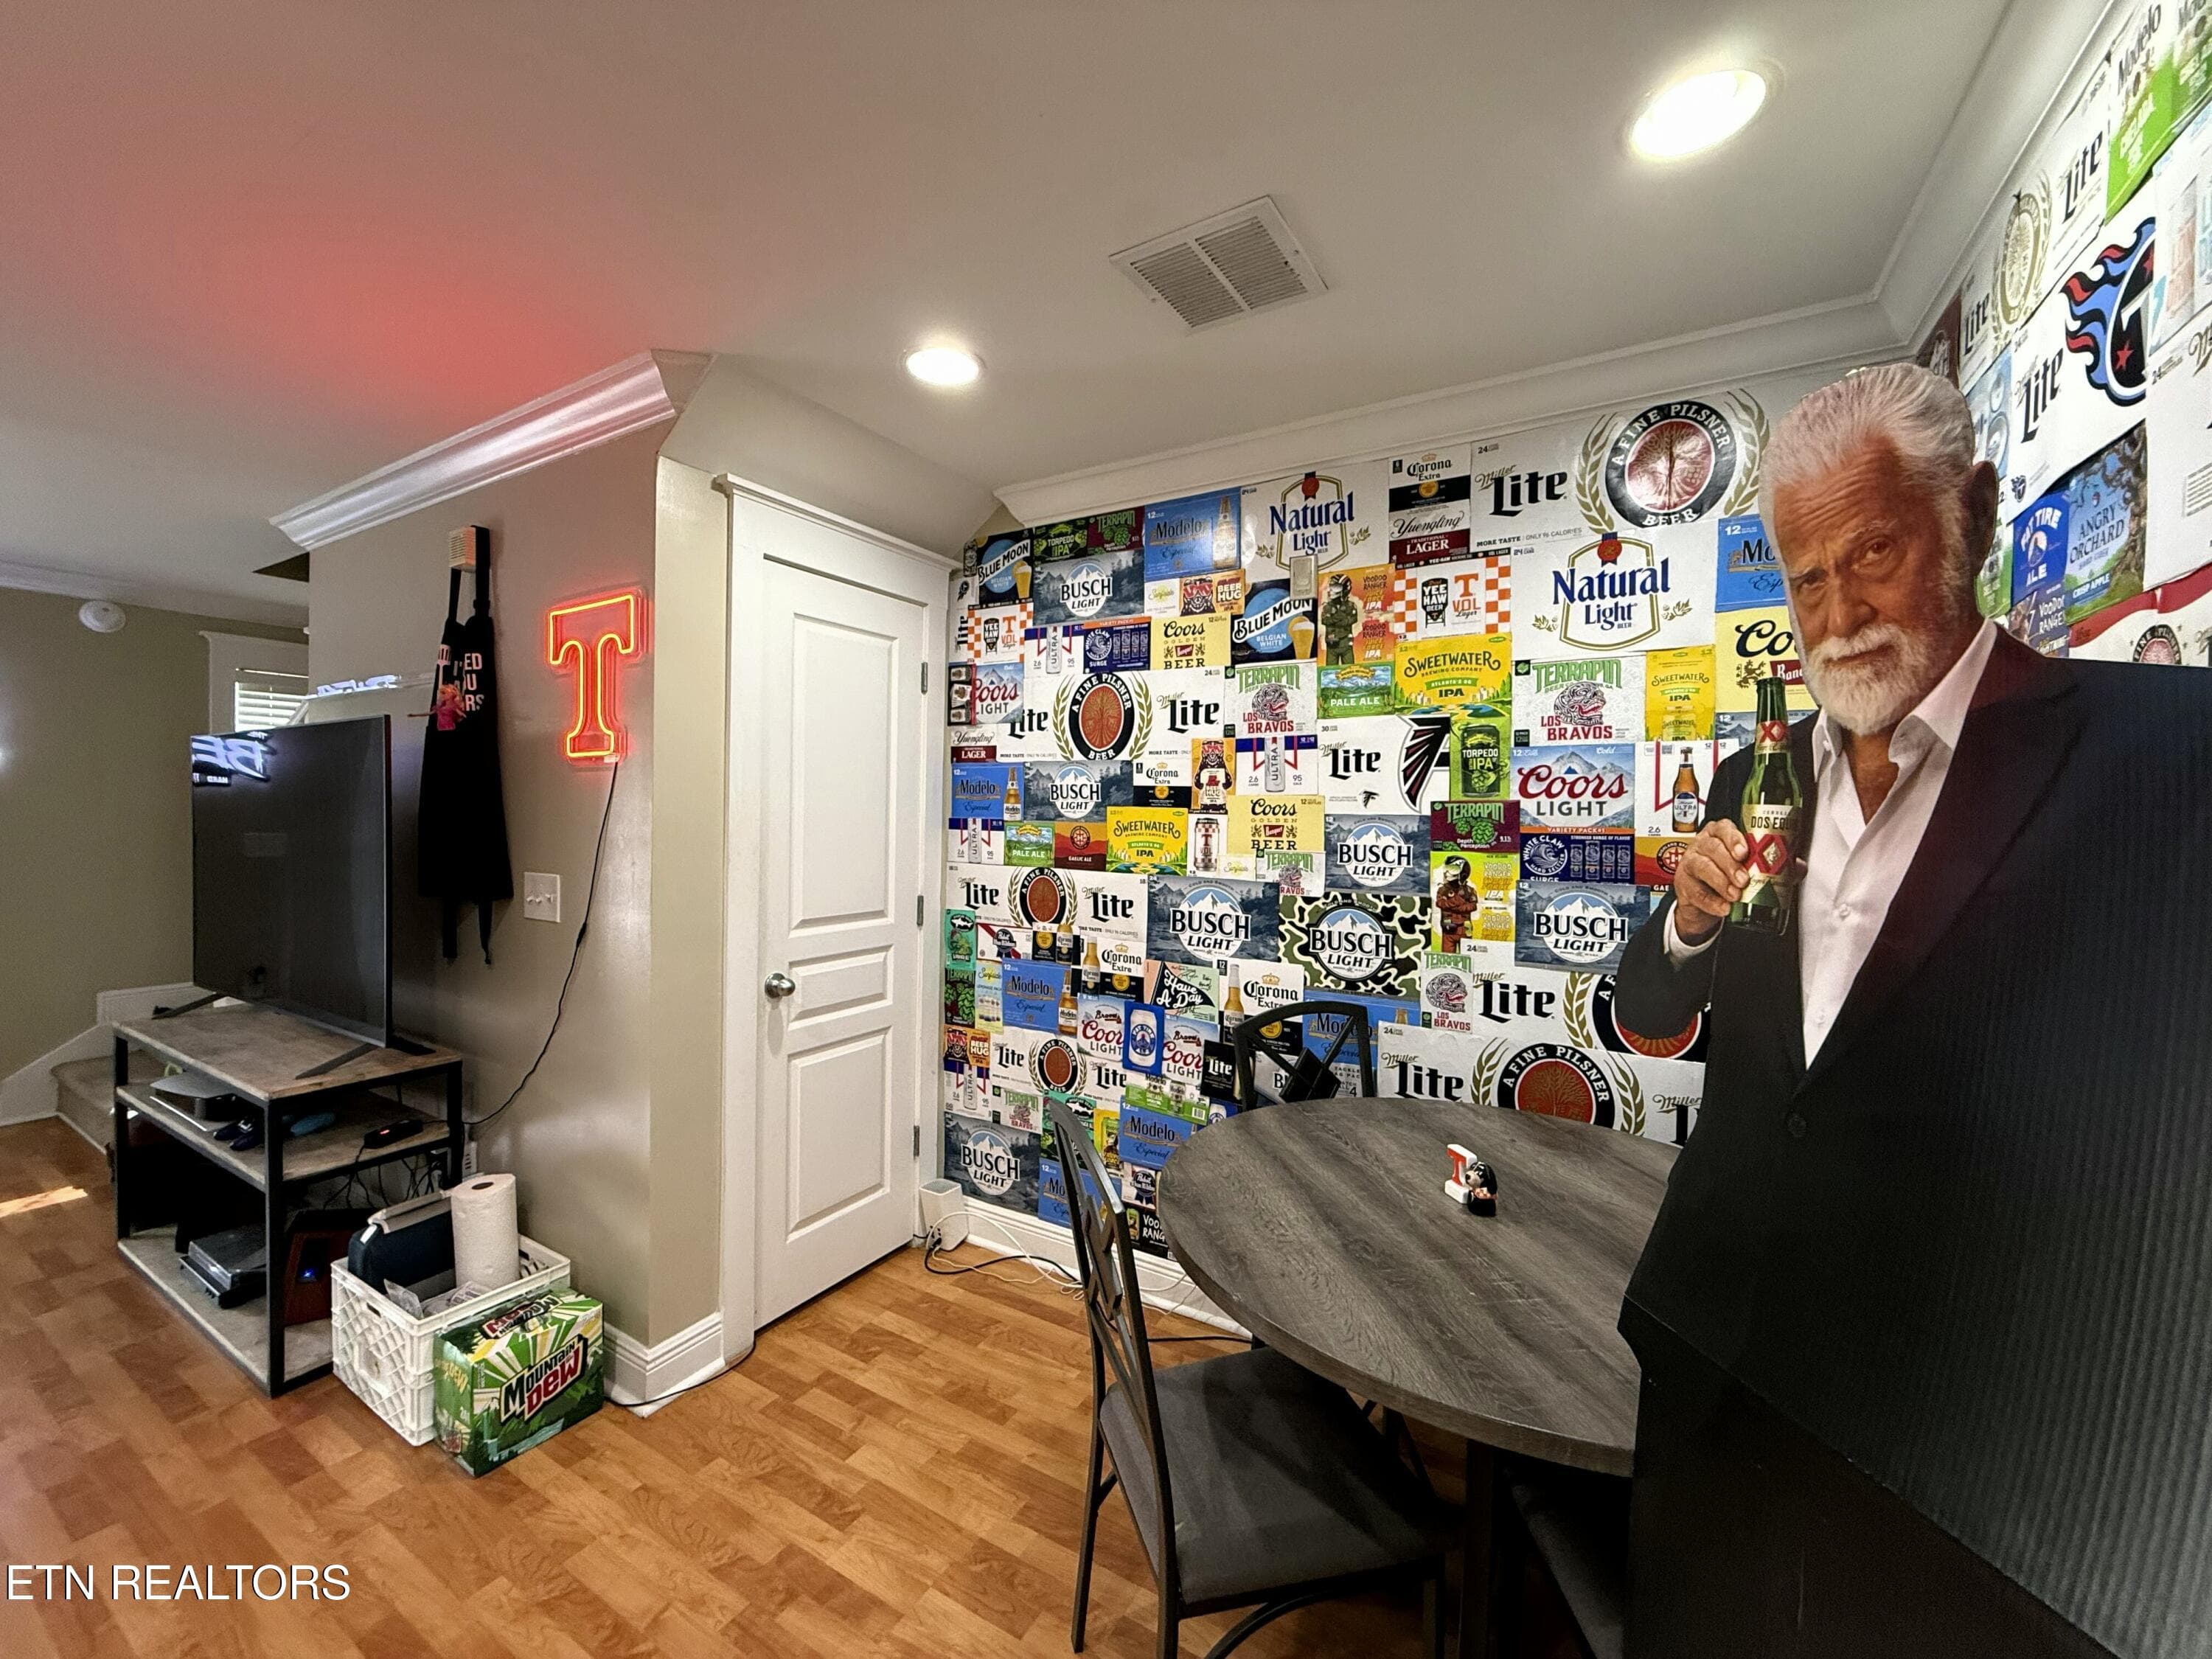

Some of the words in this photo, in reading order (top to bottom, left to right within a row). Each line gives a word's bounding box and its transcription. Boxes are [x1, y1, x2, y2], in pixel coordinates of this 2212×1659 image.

[2065, 131, 2102, 220] Lite
[2021, 348, 2063, 443] Lite
[1612, 455, 1624, 465] A
[1618, 411, 1660, 450] FINE
[1671, 405, 1731, 449] PILSNER
[1478, 445, 1488, 454] 24
[1407, 457, 1452, 477] Corona
[1418, 472, 1441, 481] Extra
[1475, 465, 1517, 491] Miller
[1490, 469, 1568, 517] Lite
[1096, 511, 1135, 532] TERRAPIN
[1270, 491, 1354, 535] Natural
[1642, 508, 1700, 526] BEER
[2035, 507, 2062, 529] TIRE
[2079, 502, 2117, 540] ANGRY
[1390, 511, 1466, 540] Yuengling
[1725, 526, 1742, 535] 12
[1048, 535, 1074, 546] TORPEDO
[1293, 532, 1329, 556] Light
[1406, 539, 1450, 554] LAGER
[1498, 535, 1521, 545] TASTE
[2070, 519, 2124, 564] ORCHARD
[1057, 544, 1069, 555] IPA
[978, 562, 1001, 582] BLUE
[1003, 542, 1029, 564] MOON
[1062, 579, 1111, 601] BUSCH
[1423, 584, 1447, 594] YEE
[1455, 573, 1478, 597] T
[1553, 557, 1671, 605] Natural
[2091, 574, 2110, 591] APPLE
[1071, 598, 1101, 609] LIGHT
[1217, 591, 1242, 602] HUG
[1424, 594, 1447, 605] HAW
[1453, 598, 1481, 612] VOL
[1366, 602, 1382, 610] IPA
[1585, 601, 1633, 631] Light
[1095, 629, 1110, 638] CLAW
[1164, 621, 1206, 638] Coors
[1234, 615, 1270, 642] BLUE
[1365, 650, 1381, 658] IPA
[1164, 658, 1205, 669] BEER
[1404, 651, 1501, 678] SWEETWATER
[1236, 664, 1300, 693] TERRAPIN
[1531, 659, 1622, 695] TERRAPIN
[1652, 672, 1709, 686] SWEETWATER
[1330, 698, 1357, 706] PALE
[1360, 697, 1380, 706] ALE
[1439, 687, 1465, 698] IPA
[1166, 699, 1220, 731] Lite
[1243, 713, 1258, 723] LOS
[1540, 716, 1561, 727] LOS
[1248, 720, 1294, 734] BRAVOS
[1548, 726, 1613, 741] BRAVOS
[961, 751, 986, 759] LAGER
[1088, 748, 1116, 761] BEER
[1319, 741, 1346, 757] Miller
[1462, 748, 1499, 758] TORPEDO
[1270, 747, 1279, 782] ULTRA
[1329, 748, 1381, 780] Lite
[1147, 768, 1178, 779] Corona
[1293, 774, 1302, 782] 95
[1518, 765, 1628, 799] Coors
[960, 779, 995, 795] Modelo
[1050, 785, 1100, 802] BUSCH
[1060, 801, 1089, 810] LIGHT
[1251, 799, 1298, 817] Coors
[1444, 803, 1504, 824] TERRAPIN
[1536, 801, 1607, 816] LIGHT
[1113, 821, 1180, 839] SWEETWATER
[1751, 816, 1770, 829] DOS
[1136, 849, 1154, 858] IPA
[1251, 840, 1297, 850] BEER
[1523, 837, 1538, 860] WHITE
[1540, 835, 1564, 849] CLAW
[1265, 852, 1313, 872] TERRAPIN
[1338, 844, 1413, 867] BUSCH
[1353, 865, 1397, 877] LIGHT
[964, 882, 1000, 910] Lite
[1486, 890, 1504, 898] IPA
[1091, 891, 1133, 922] Lite
[1171, 910, 1251, 940] BUSCH
[1534, 913, 1627, 942] BUSCH
[1187, 935, 1233, 950] LIGHT
[1310, 928, 1393, 957] BUSCH
[1553, 939, 1608, 953] LIGHT
[1102, 949, 1142, 965] Corona
[1219, 960, 1225, 968] 12
[1328, 955, 1374, 969] LIGHT
[1425, 953, 1472, 974] TERRAPIN
[1112, 963, 1132, 973] Extra
[1012, 975, 1049, 995] Modelo
[1164, 970, 1198, 994] Have
[1472, 971, 1506, 989] Miller
[1156, 990, 1171, 1007] A
[1173, 992, 1203, 1009] Day
[1243, 980, 1298, 1002] Corona
[1478, 978, 1556, 1023] Lite
[1434, 1018, 1470, 1031] BRAVOS
[1436, 1012, 1450, 1020] LOS
[970, 1048, 988, 1056] HUG
[997, 1046, 1024, 1068] Lite
[1380, 1051, 1419, 1069] Miller
[1208, 1059, 1232, 1075] Lite
[1508, 1047, 1547, 1076] FINE
[1096, 1065, 1127, 1093] Lite
[1166, 1063, 1202, 1079] LIGHT
[1556, 1046, 1610, 1102] PILSNER
[1396, 1060, 1464, 1102] Lite
[1503, 1077, 1514, 1087] A
[1652, 1094, 1703, 1113] Miller
[1130, 1116, 1175, 1141] Modelo
[961, 1145, 1018, 1180] BUSCH
[973, 1170, 1006, 1187] LIGHT
